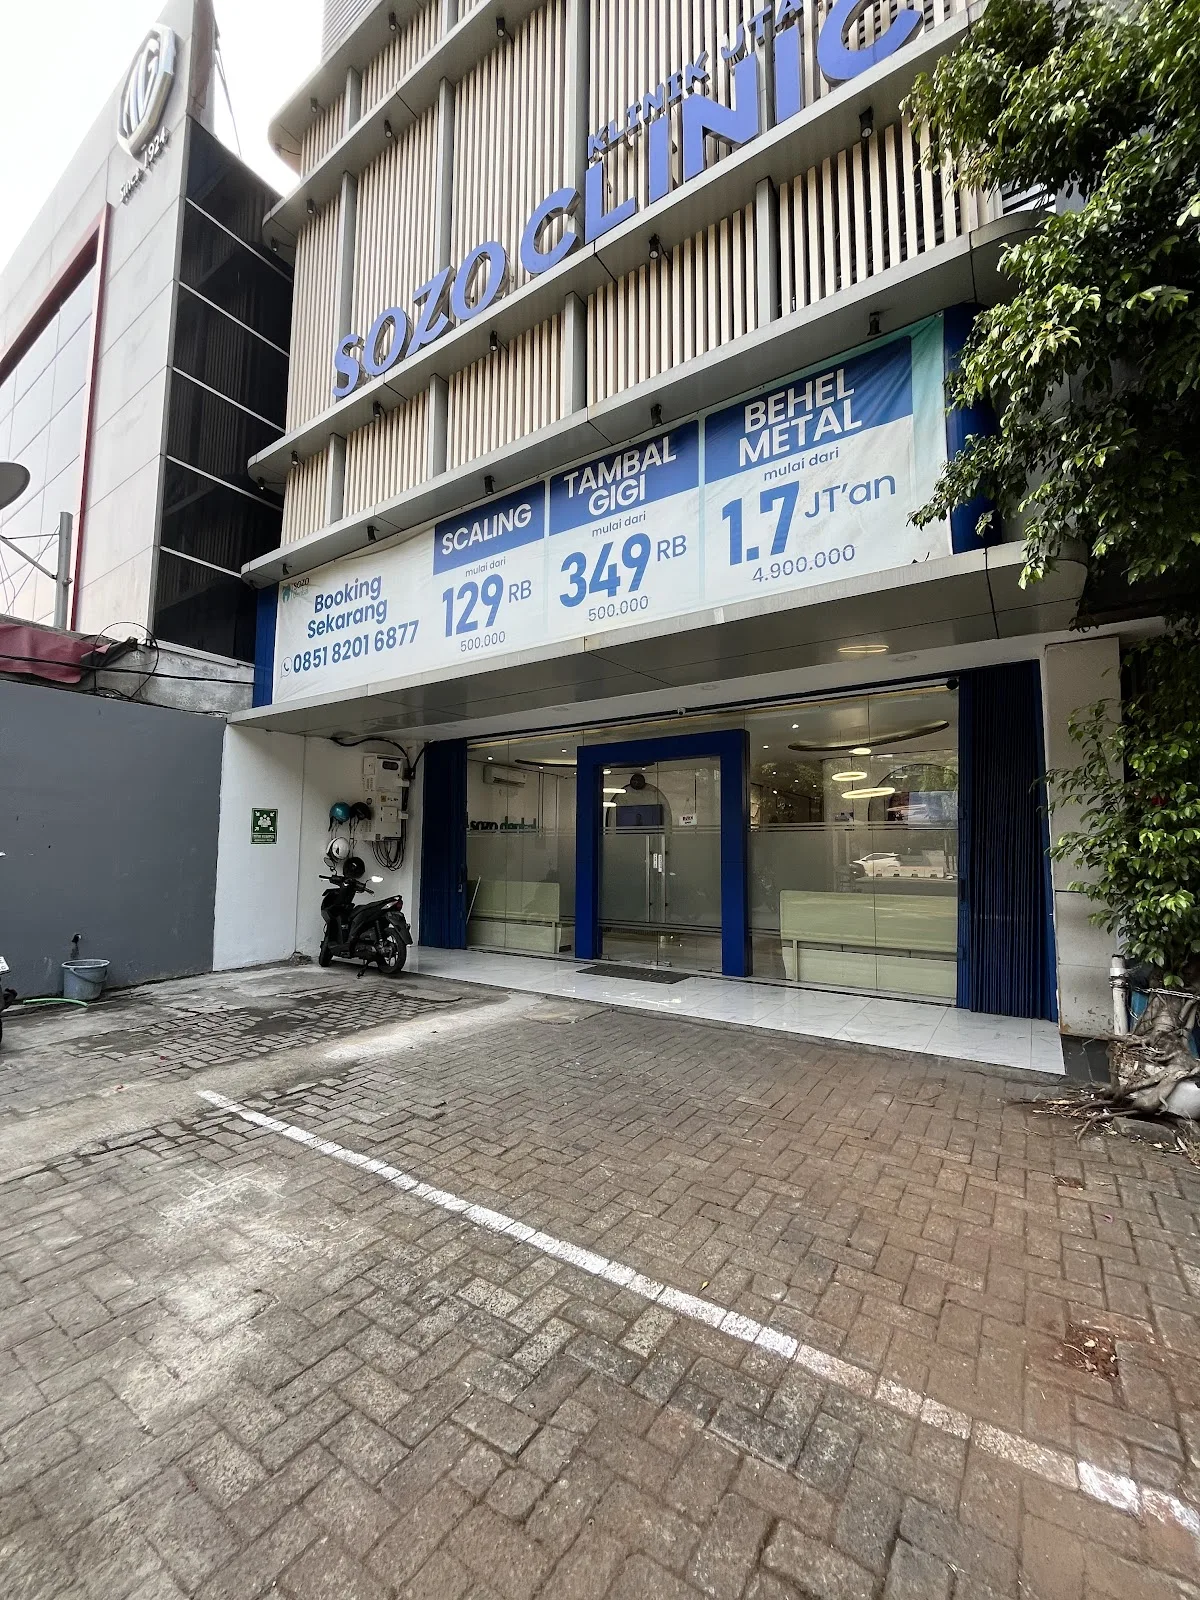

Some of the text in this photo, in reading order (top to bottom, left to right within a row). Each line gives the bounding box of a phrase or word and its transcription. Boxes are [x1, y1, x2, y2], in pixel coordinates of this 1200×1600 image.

[588, 50, 709, 160] KLINIK
[144, 125, 166, 168] 1924
[332, 0, 923, 397] SOZO CLINIC
[744, 368, 855, 434] BEHEL
[739, 398, 863, 467] METAL
[563, 436, 677, 498] TAMBAL
[763, 446, 839, 482] mulai dari
[588, 473, 646, 516] GIGI
[441, 503, 532, 555] SCALING
[592, 510, 646, 538] mulai dari
[722, 473, 896, 566] 1.7 JT'an
[465, 556, 506, 578] mulai dari
[559, 532, 687, 608] 349 RB
[752, 544, 856, 583] 4.900.000
[314, 575, 382, 614] Booking
[442, 573, 532, 637] 129 RB
[588, 595, 649, 622] 500.000
[307, 599, 388, 639] Sekarang
[460, 630, 506, 652] 500.000
[293, 619, 420, 673] 0851 8201 6877
